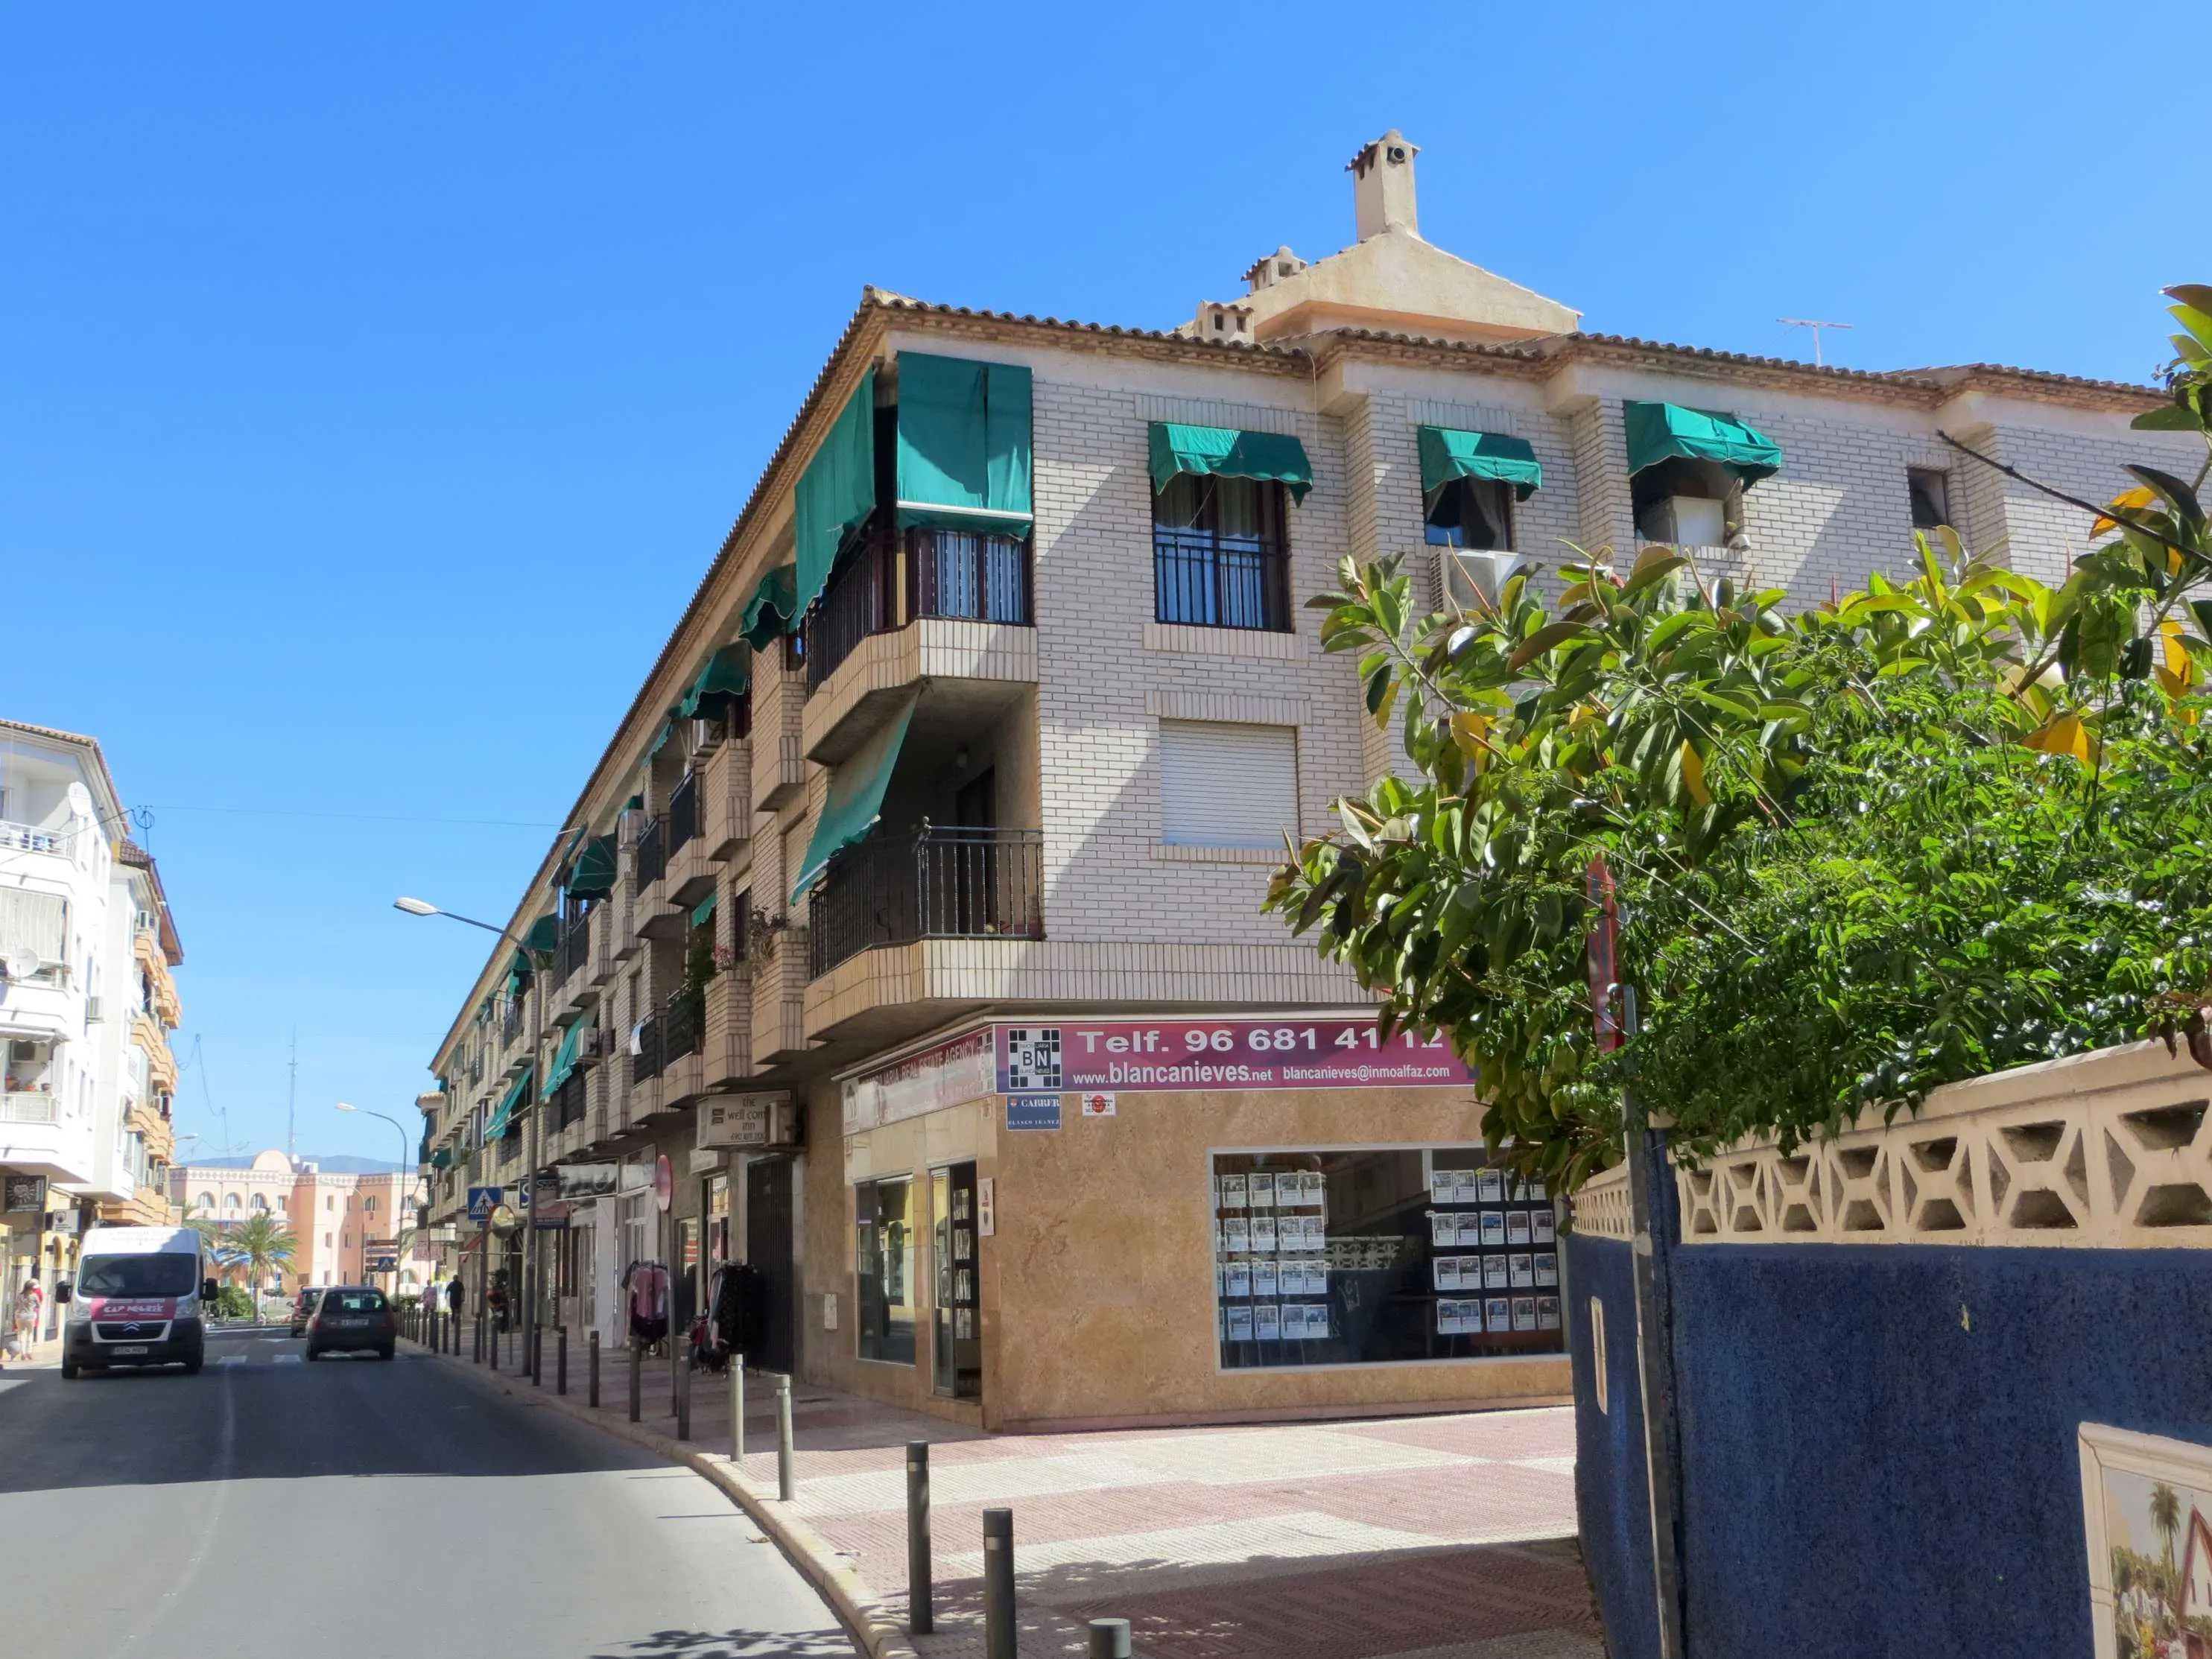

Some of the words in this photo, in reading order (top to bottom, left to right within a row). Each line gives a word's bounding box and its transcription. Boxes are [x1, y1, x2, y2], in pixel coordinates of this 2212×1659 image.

[945, 1039, 975, 1067] AGENCY
[1077, 1030, 1169, 1053] Telf.
[1185, 1030, 1234, 1052] 96
[1248, 1028, 1316, 1051] 681
[1334, 1027, 1378, 1050] 41
[1400, 1028, 1443, 1048] 12
[1073, 1060, 1273, 1085] www.blancanieves.net
[1283, 1065, 1450, 1081] blancanieves@inmoalfaz.com
